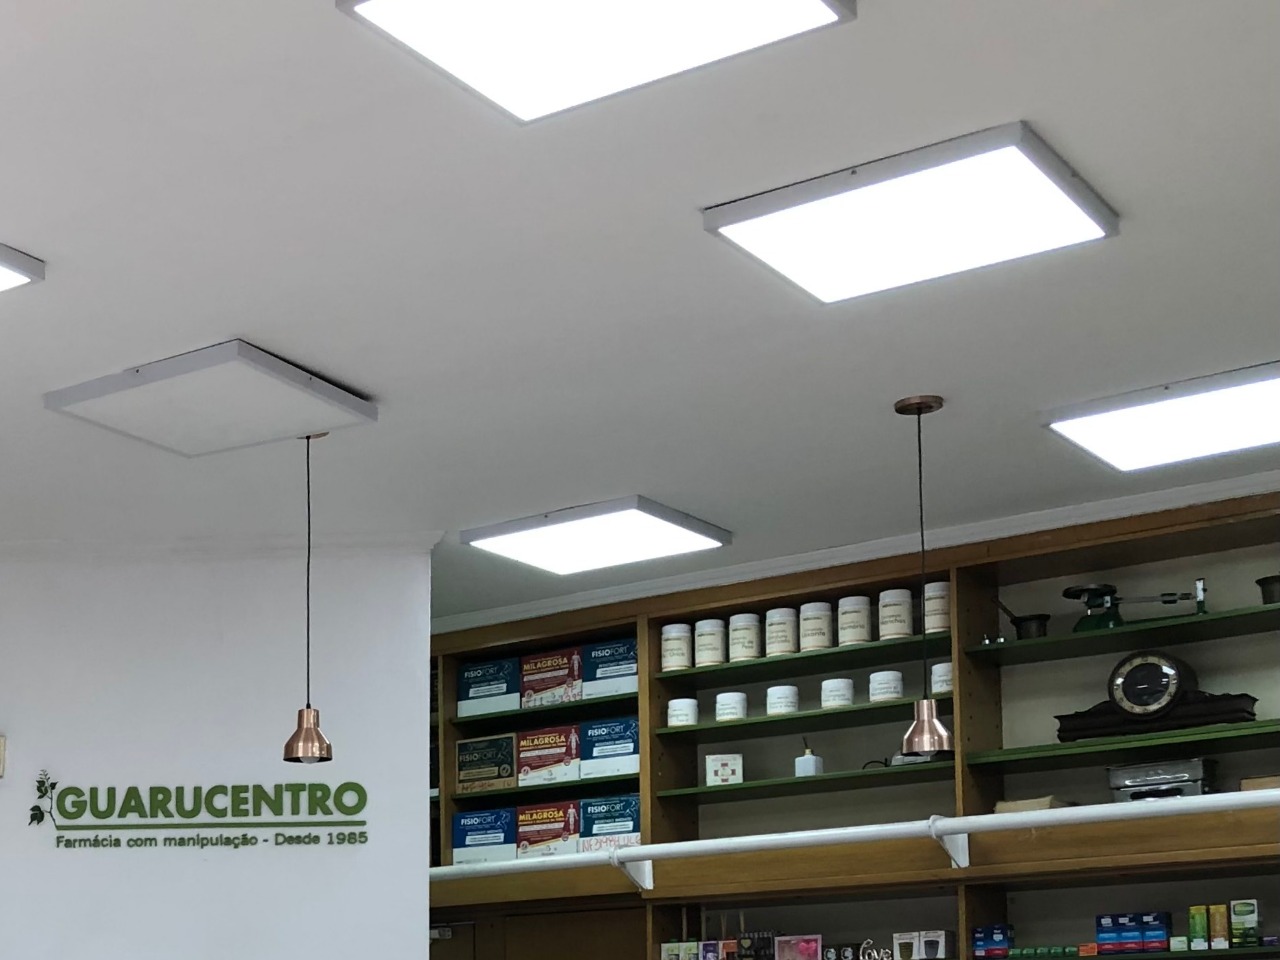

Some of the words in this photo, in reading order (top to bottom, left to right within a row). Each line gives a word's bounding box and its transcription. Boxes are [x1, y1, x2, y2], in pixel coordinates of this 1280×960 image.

[523, 656, 569, 671] MILAGROSA
[587, 723, 625, 737] FISIOFORT
[520, 733, 567, 748] MILAGROSA
[56, 782, 368, 820] GUARUCENTRO
[587, 801, 625, 815] FISIOFORT
[460, 814, 496, 827] FISIOFORT
[518, 808, 565, 823] MILAGROSA
[56, 834, 121, 849] Farmácia
[126, 836, 158, 848] com
[163, 833, 259, 850] manipulação
[274, 832, 321, 847] Desde
[327, 831, 368, 846] 1985
